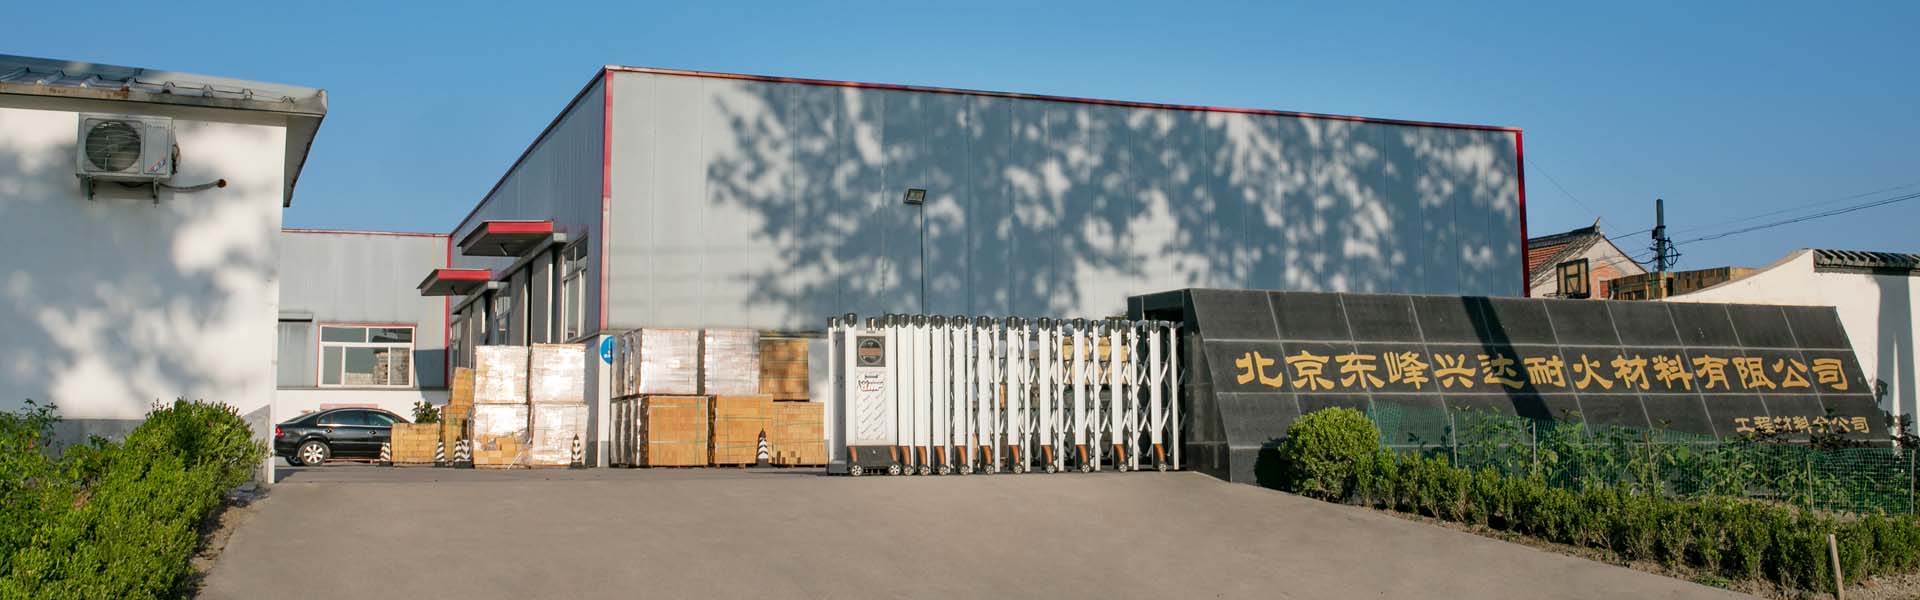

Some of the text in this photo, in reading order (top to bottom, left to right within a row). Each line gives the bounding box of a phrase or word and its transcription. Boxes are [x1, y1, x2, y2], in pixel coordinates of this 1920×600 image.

[1235, 350, 1848, 391] 北京东峰兴达耐火材料有限公司
